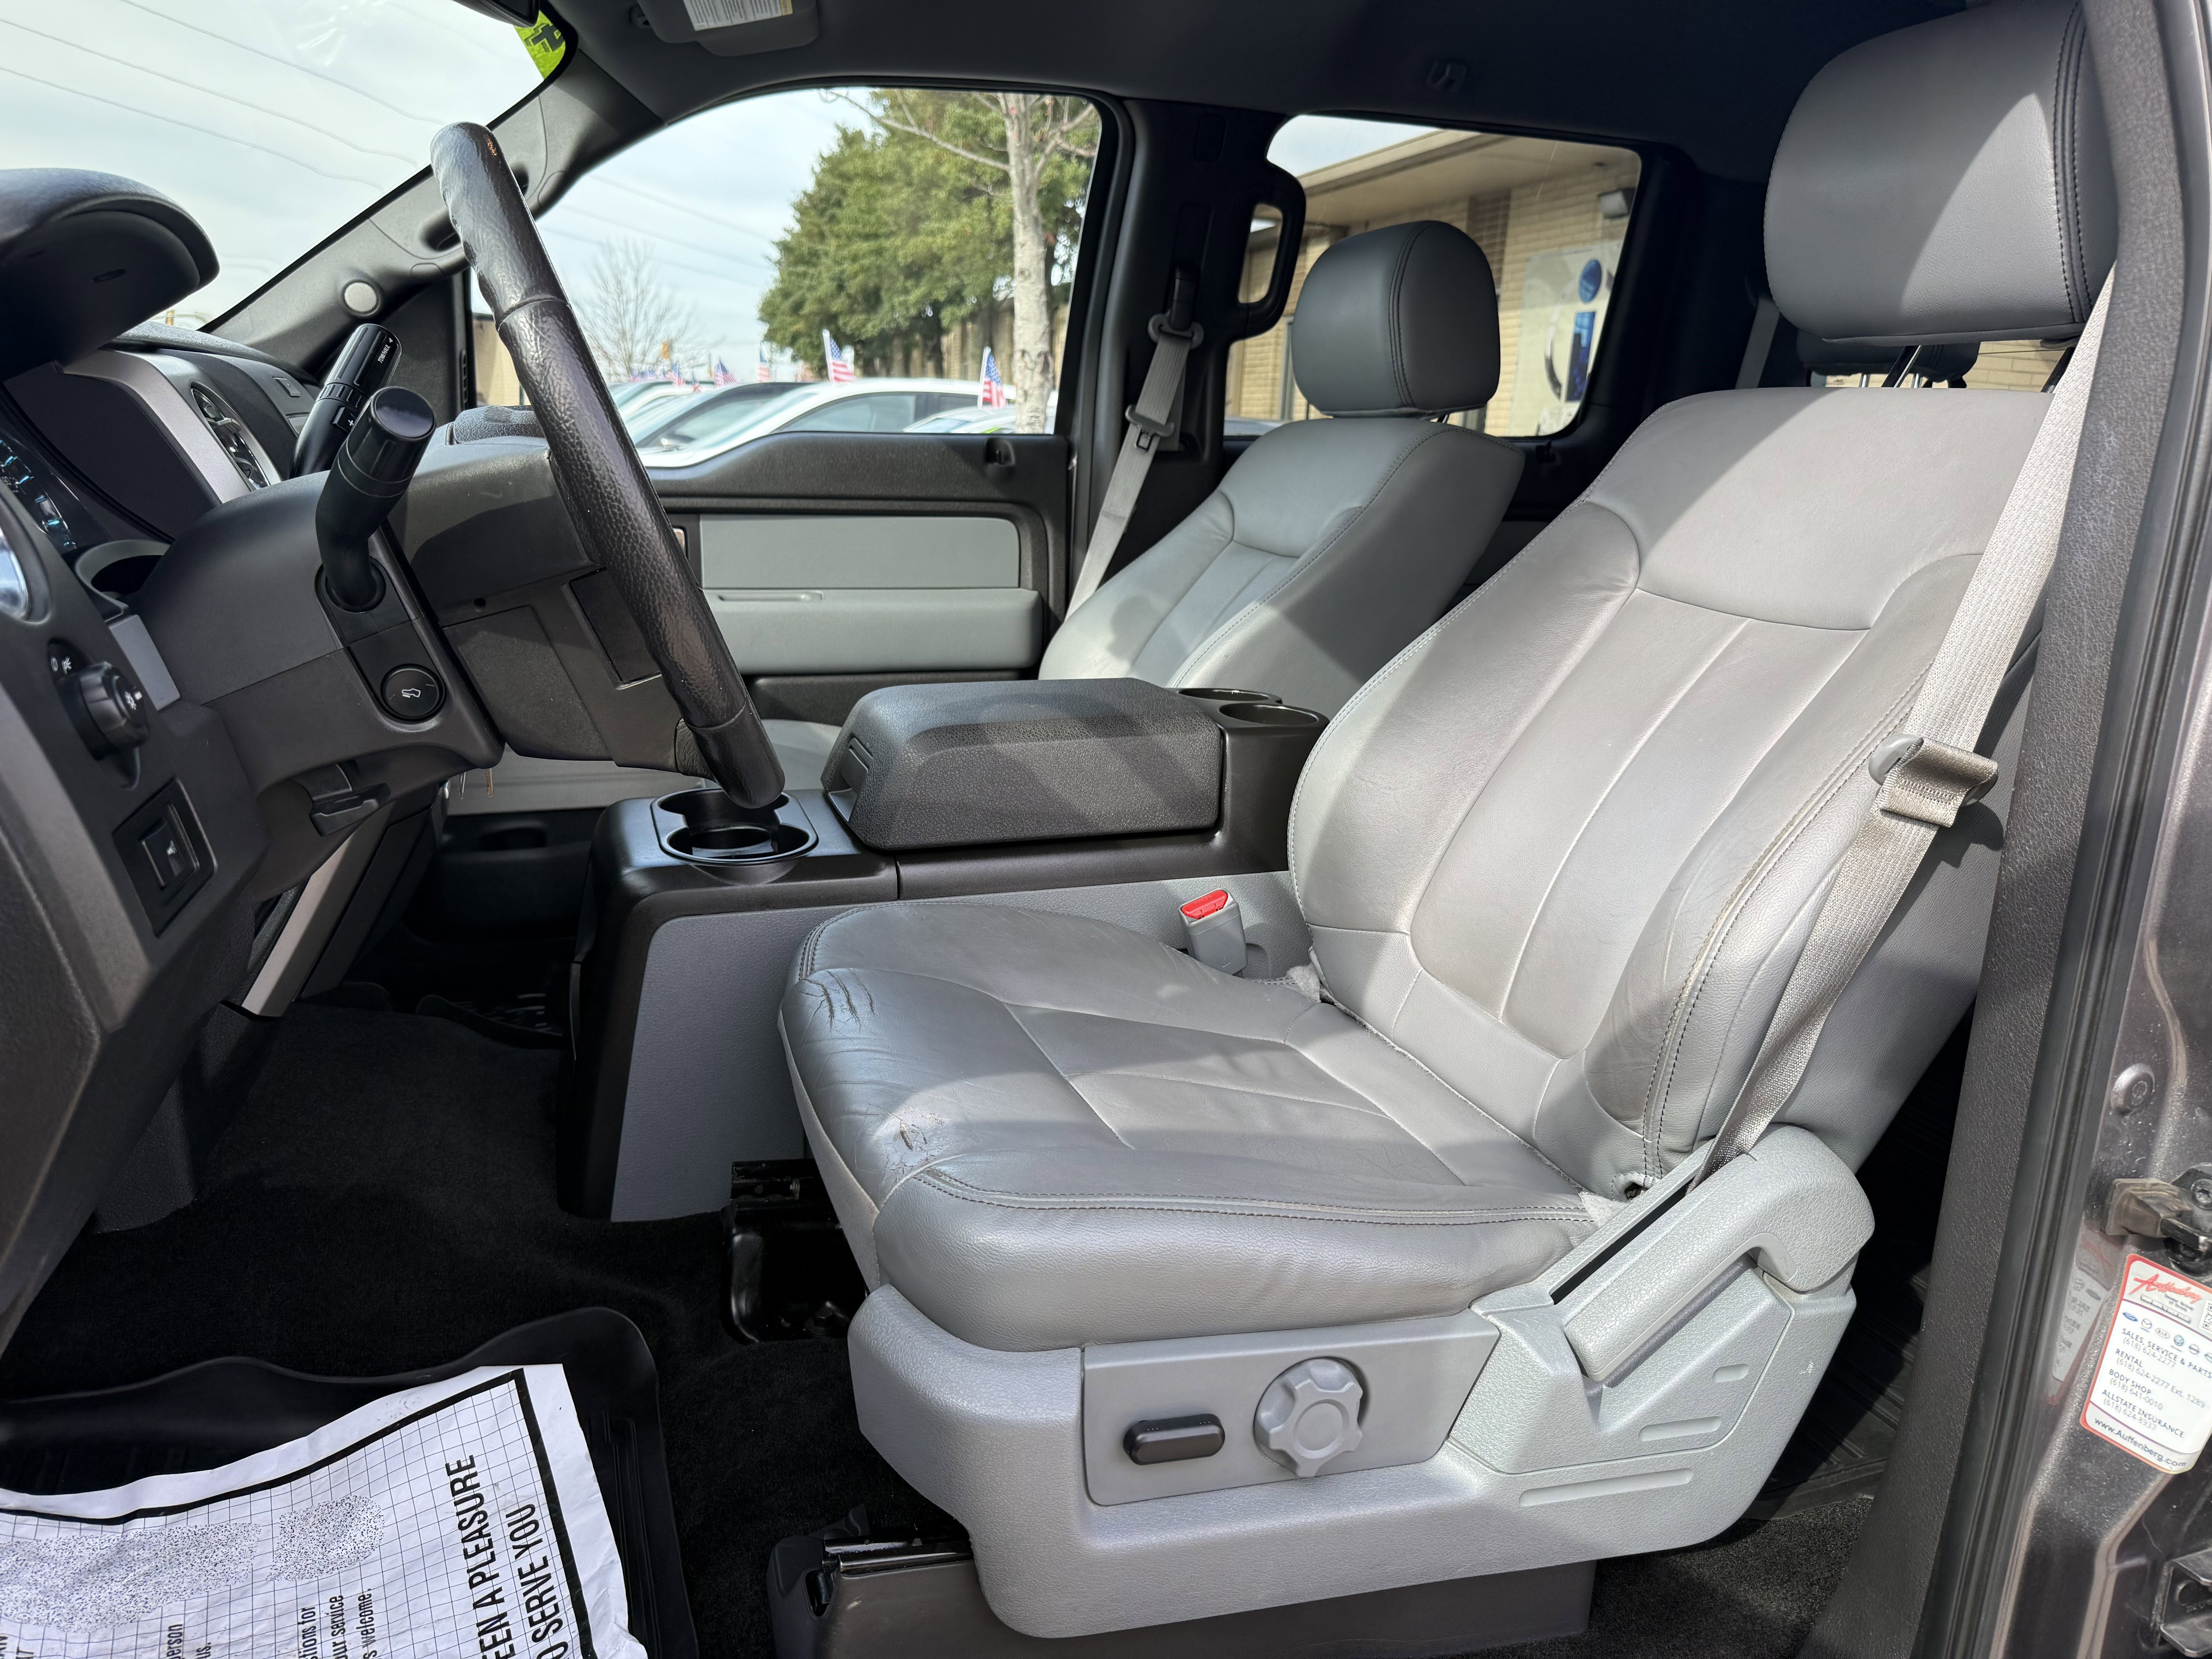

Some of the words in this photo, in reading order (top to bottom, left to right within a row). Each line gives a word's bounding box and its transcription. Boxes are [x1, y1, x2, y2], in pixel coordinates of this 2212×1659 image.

[2115, 1348, 2143, 1368] RENTAL
[2122, 1328, 2144, 1346] SALES,
[2147, 1341, 2178, 1361] SERVICE
[2188, 1362, 2212, 1379] PARTS
[2123, 1337, 2141, 1352] (618)
[2142, 1347, 2176, 1368] 624-2277
[2109, 1369, 2130, 1384] BODY
[2130, 1380, 2152, 1395] SHOP
[2116, 1357, 2135, 1372] (618)
[2135, 1367, 2170, 1389] 624-2277
[2103, 1398, 2122, 1413] (618)
[2110, 1377, 2128, 1393] (618)
[2129, 1388, 2163, 1410] 641-0010
[2102, 1389, 2137, 1412] ALLSTATE
[2138, 1408, 2185, 1439] INSURANCE
[2094, 1418, 2186, 1467] www.Auffenberg.com
[445, 1454, 500, 1590] PLEASURE
[505, 1504, 543, 1560] YOU
[297, 1607, 316, 1625] for
[329, 1595, 346, 1637] service
[473, 1587, 505, 1609] A
[517, 1555, 564, 1643] SERVE
[356, 1588, 376, 1649] welcome.
